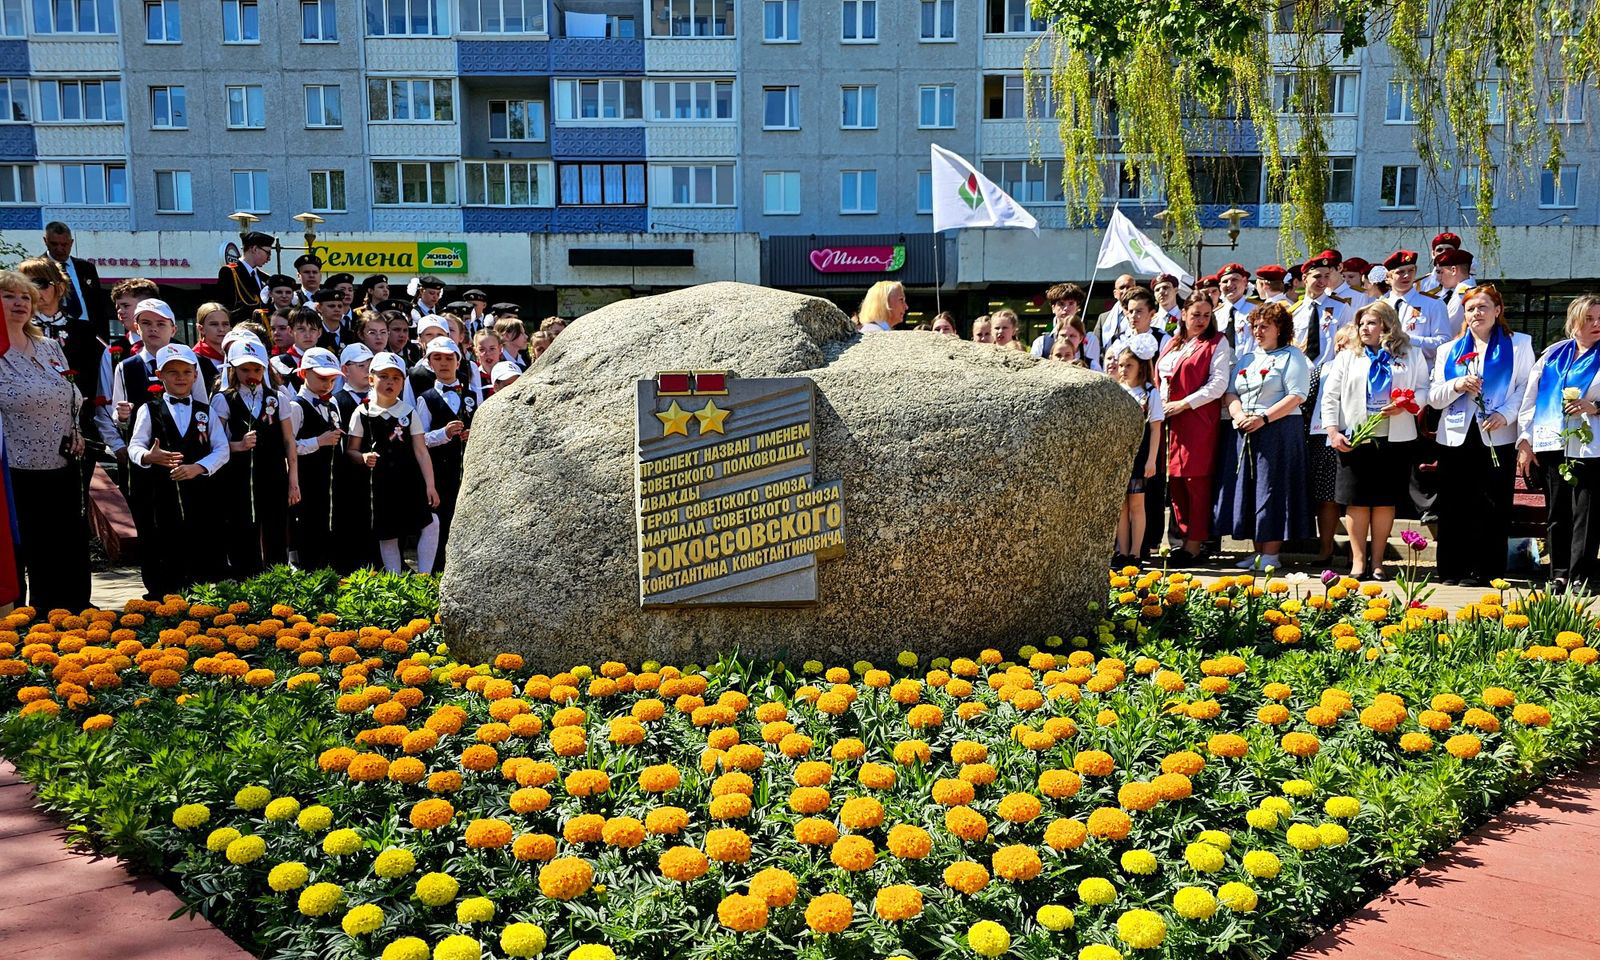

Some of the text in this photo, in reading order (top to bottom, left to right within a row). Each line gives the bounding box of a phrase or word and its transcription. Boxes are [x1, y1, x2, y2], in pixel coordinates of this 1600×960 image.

[311, 246, 413, 267] Семена
[822, 250, 885, 268] Мила
[640, 422, 811, 478] ПРОСПЕКТ НАЗВАН ИМЕНЕМ
[640, 466, 714, 495] СОВЕТСКОГО
[640, 486, 700, 513] ДВАЖДЫ
[641, 508, 678, 532] ГЕРОЯ
[685, 488, 759, 521] СОВЕТСКОГО
[641, 485, 840, 549] МАРШАЛА СОВЕТСКОГО СОЮЗА
[642, 503, 842, 577] РОКОССОВСКОГО
[642, 559, 728, 595] КОНСТАНТИНА
